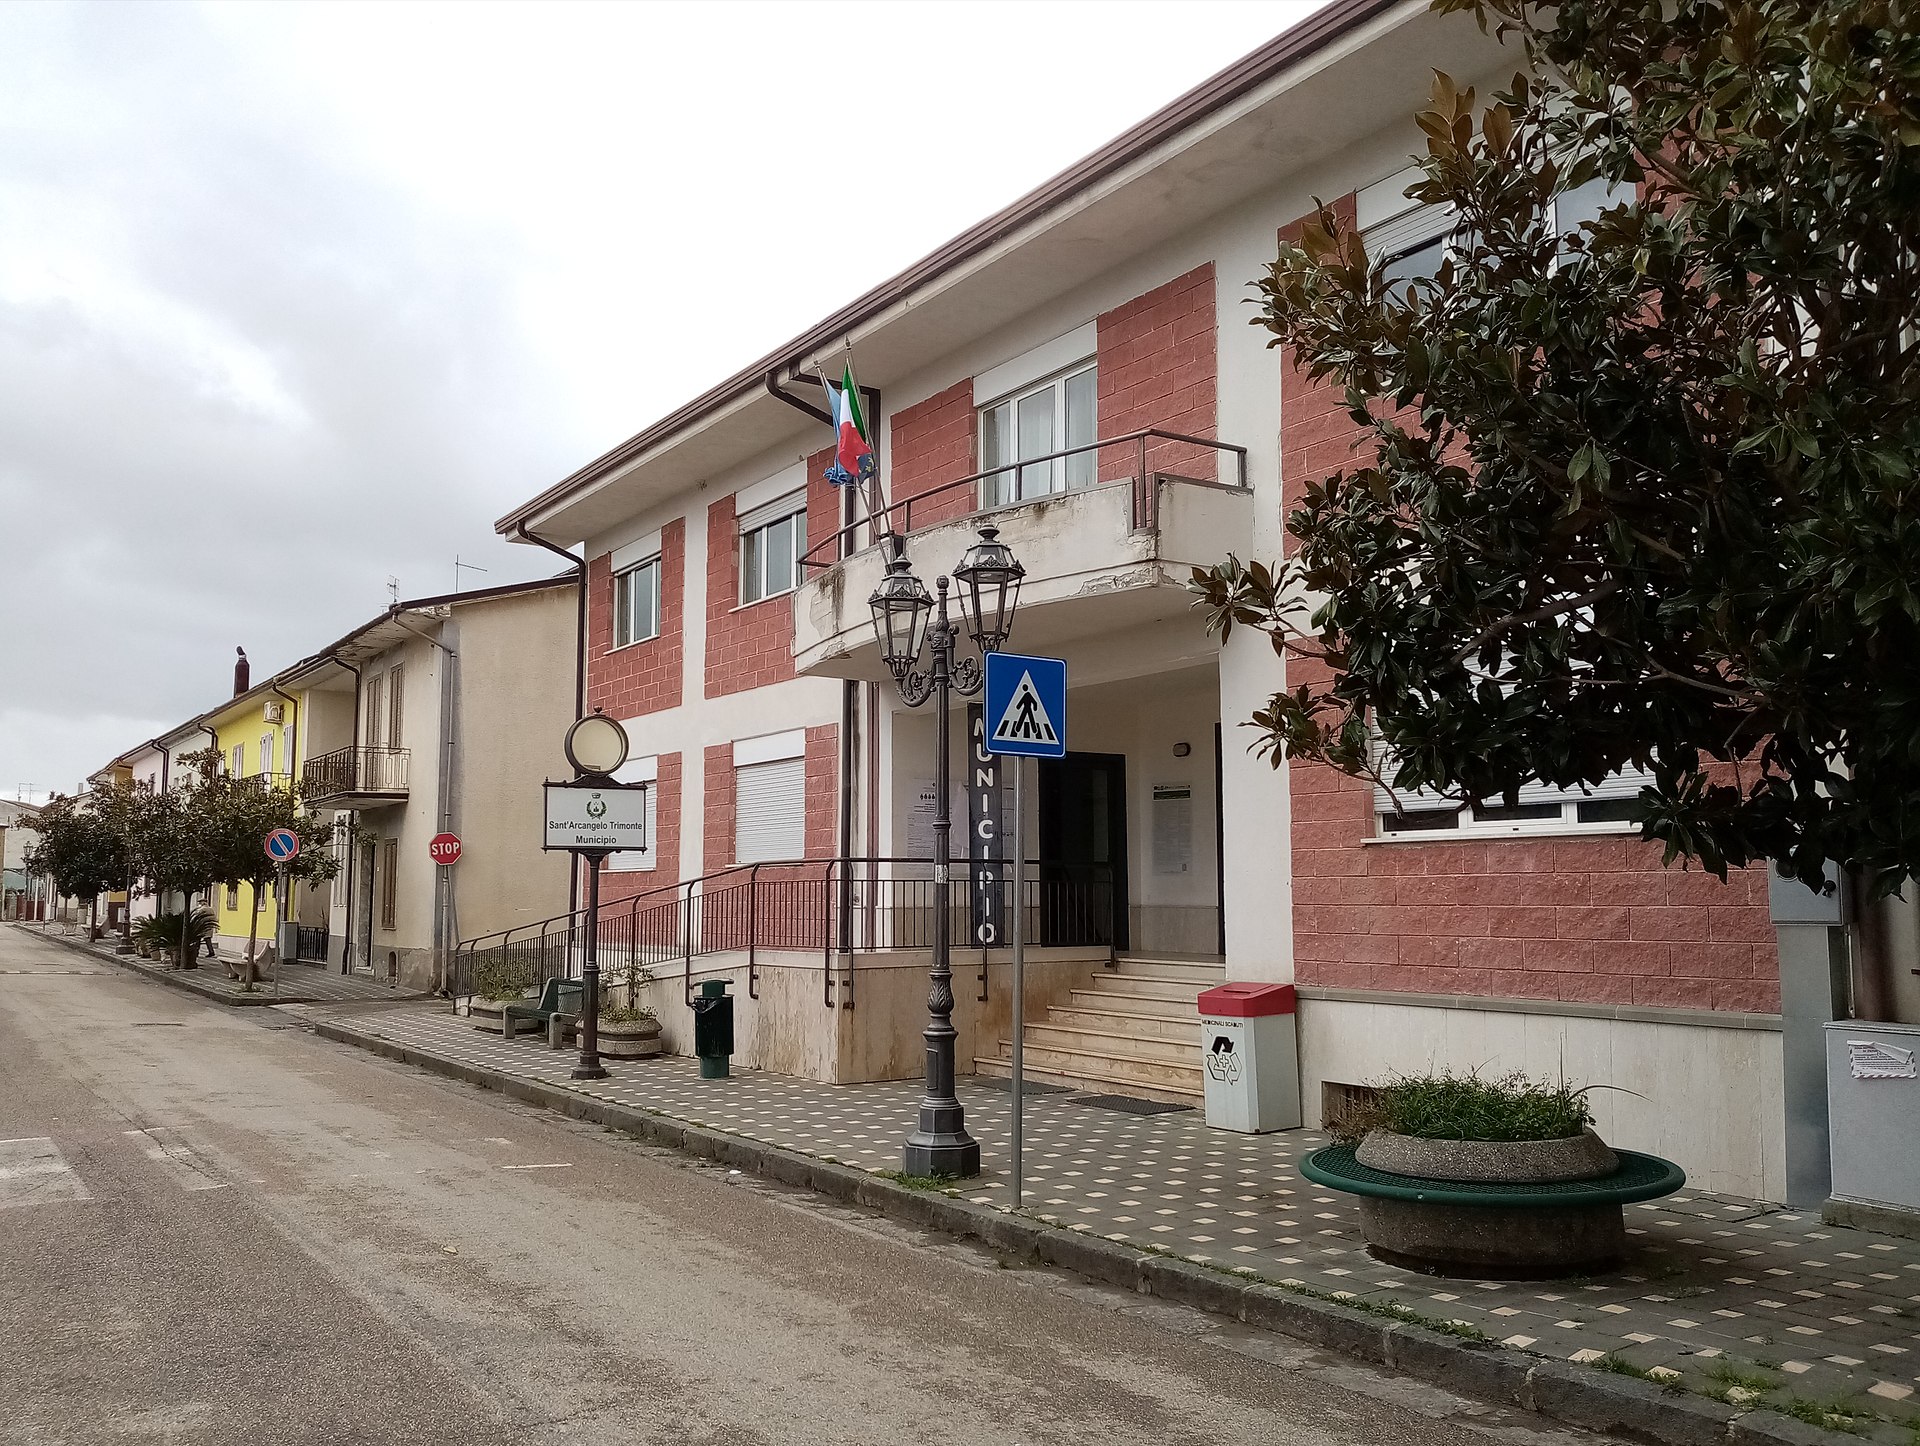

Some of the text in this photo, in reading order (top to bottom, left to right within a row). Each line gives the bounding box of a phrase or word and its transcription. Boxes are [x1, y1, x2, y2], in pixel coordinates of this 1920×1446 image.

[549, 821, 642, 831] Sant'Arcangelo Trimonte
[575, 835, 617, 845] Municipio
[431, 842, 460, 855] STOP
